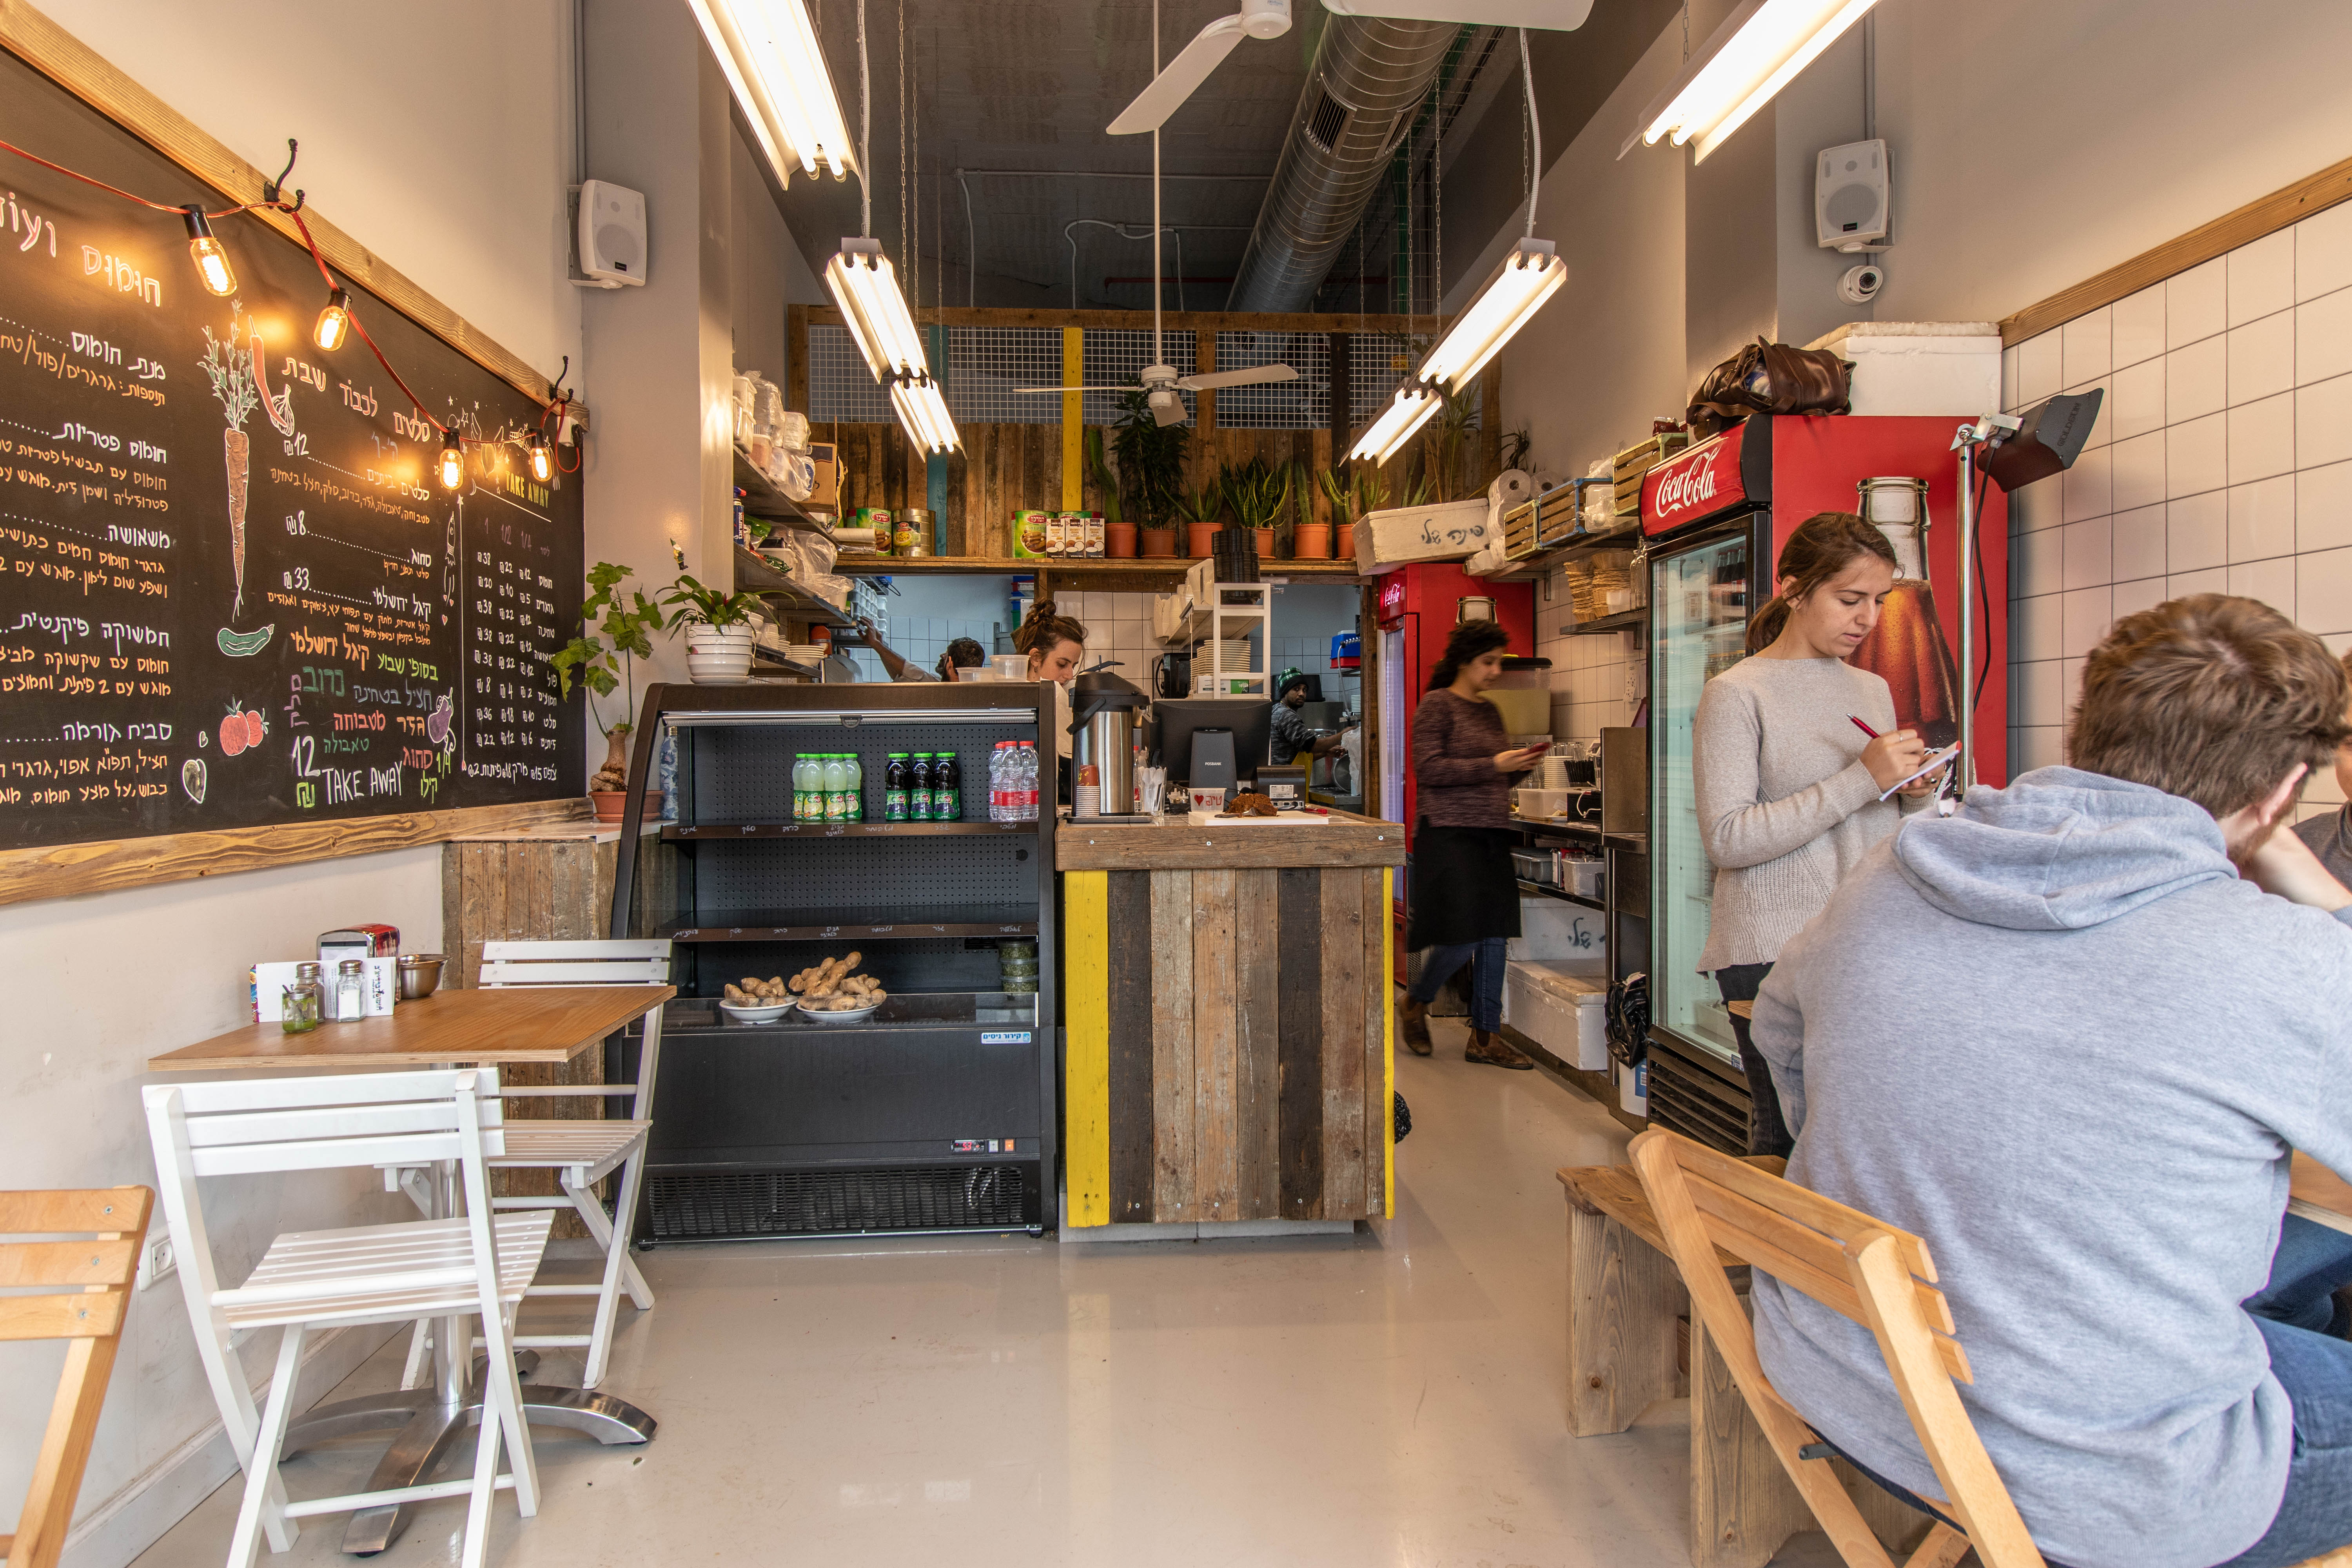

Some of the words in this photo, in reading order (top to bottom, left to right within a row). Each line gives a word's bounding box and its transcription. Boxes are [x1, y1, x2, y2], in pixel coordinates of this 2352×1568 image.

[71, 332, 122, 365] חומוס
[128, 357, 166, 380] מנת
[281, 357, 327, 392] שבת
[393, 408, 430, 442] סלטים
[52, 423, 121, 452] פטריות
[17, 444, 60, 464] פטריות
[62, 450, 104, 473] תבשיל
[129, 440, 167, 463] חומוס
[110, 466, 127, 480] עם
[134, 472, 167, 490] חומוס
[1655, 445, 1722, 518] Coca-Cola
[82, 485, 107, 503] ושמן
[401, 479, 430, 501] סלטים
[505, 470, 525, 498] TAKE
[528, 482, 549, 508] AWAY
[108, 524, 171, 549] משאושה
[57, 542, 91, 561] חמים
[99, 552, 129, 570] חומוס
[411, 548, 431, 567] סחוג
[15, 561, 34, 577] עם
[40, 563, 75, 582] מוגש
[134, 559, 165, 573] גרגרי
[416, 567, 429, 579] סלט
[114, 576, 135, 590] שום
[538, 575, 553, 589] חומוס
[267, 592, 297, 606] ואגוזים
[372, 585, 408, 612] ירושלמי
[413, 593, 431, 622] קיגל
[11, 612, 90, 644] פיקנטית
[363, 612, 373, 623] עם
[101, 622, 169, 657] חמשוקה
[290, 626, 338, 657] ירושלמי
[343, 633, 370, 671] קיגל
[44, 652, 100, 675] שקשוקה
[109, 657, 128, 670] עם
[137, 658, 169, 675] חומוס
[377, 653, 405, 675] שבוע
[2, 673, 53, 692] וחמוצים
[59, 675, 95, 695] פיתות
[98, 680, 110, 695] 2
[115, 681, 134, 697] עם
[139, 682, 171, 696] מוגש
[303, 666, 345, 697] כרוב
[354, 684, 401, 704] בטחינה
[405, 679, 432, 711] חציל
[538, 691, 557, 706] חמוצים
[333, 710, 386, 731] מטבוחה
[396, 715, 425, 737] גזר
[543, 713, 557, 729] סלט
[128, 723, 172, 740] סביח
[323, 731, 370, 754] טאבולה
[292, 735, 321, 778] 12
[403, 746, 433, 770] סחוג
[321, 768, 364, 805] TAKE
[370, 760, 403, 797] AWAY
[512, 762, 528, 784] מרק
[79, 784, 110, 801] מצע
